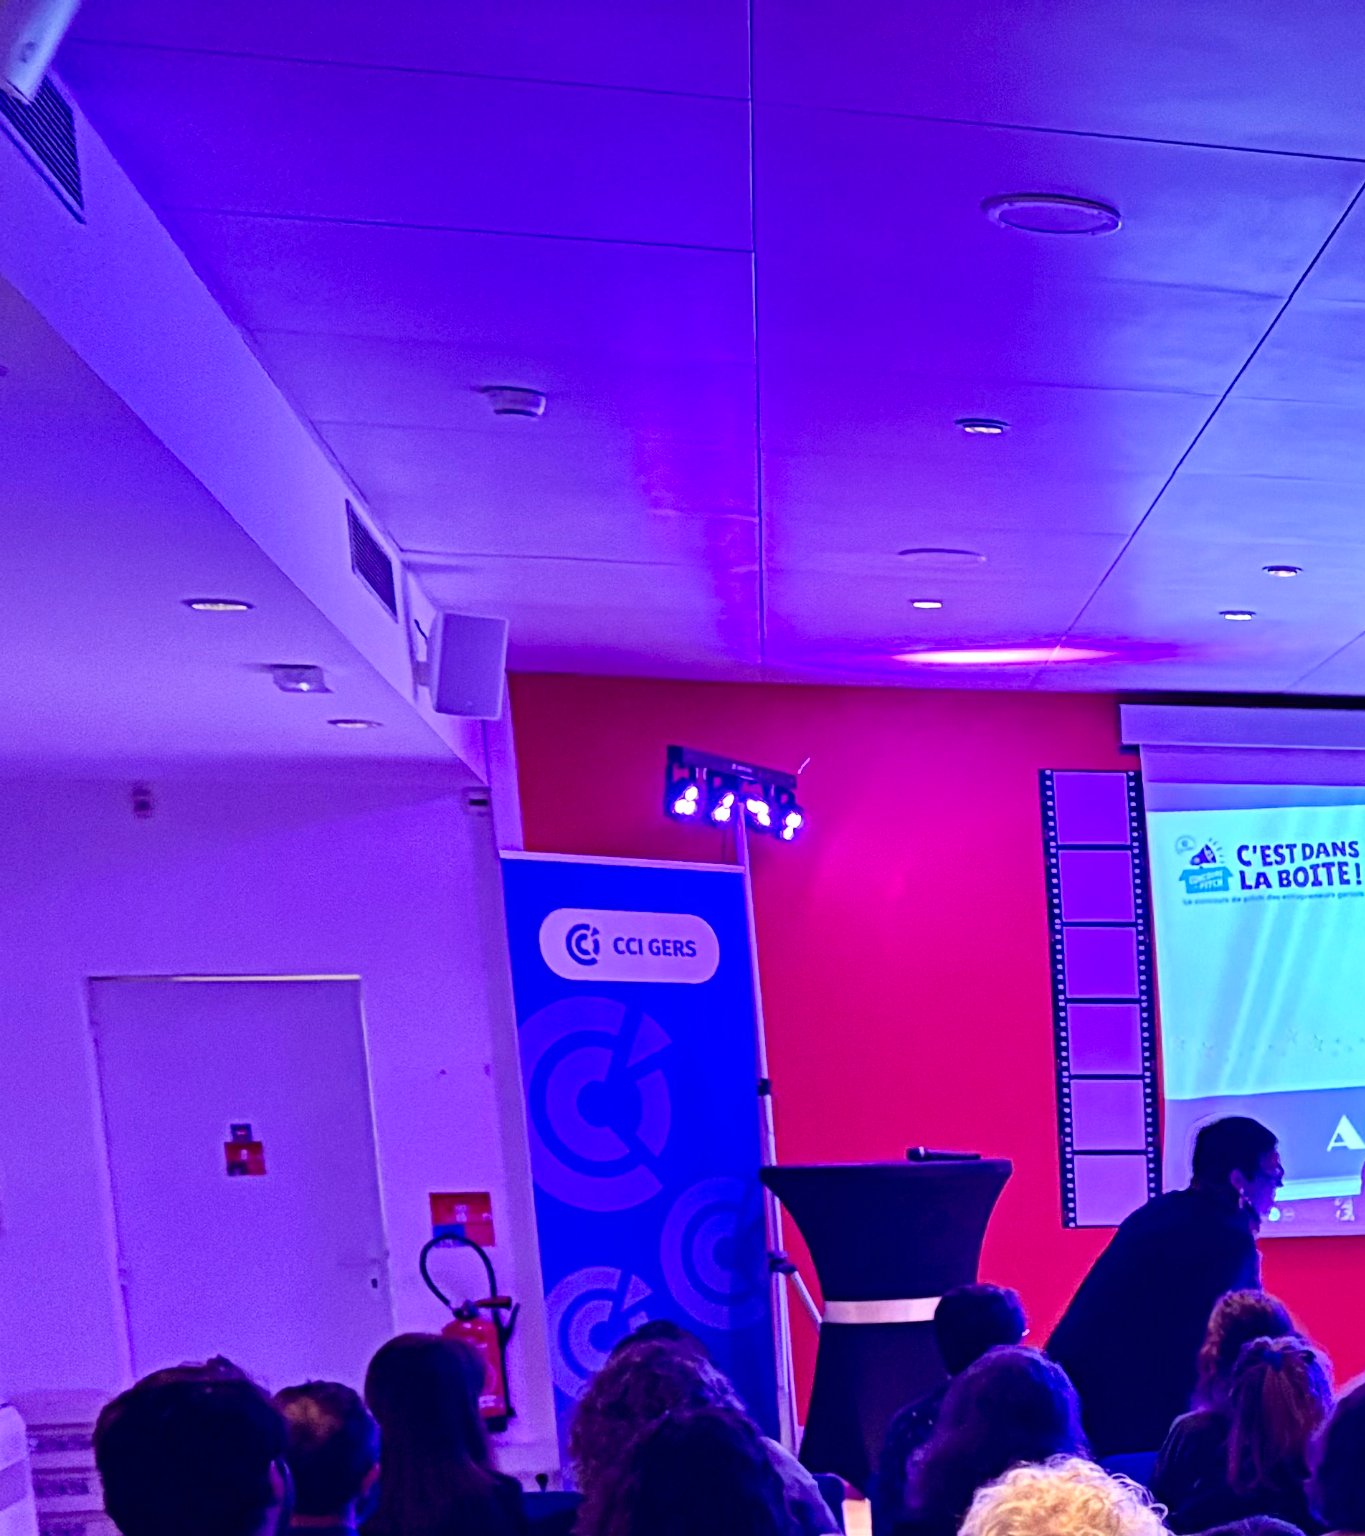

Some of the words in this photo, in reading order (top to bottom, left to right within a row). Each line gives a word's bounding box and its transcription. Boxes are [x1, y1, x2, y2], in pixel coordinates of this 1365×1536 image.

[1236, 843, 1297, 868] C'EST
[1301, 840, 1360, 861] DANS
[1238, 870, 1273, 890] LA
[1277, 861, 1351, 888] BOITE
[613, 937, 643, 955] CCI
[648, 938, 697, 957] GERS
